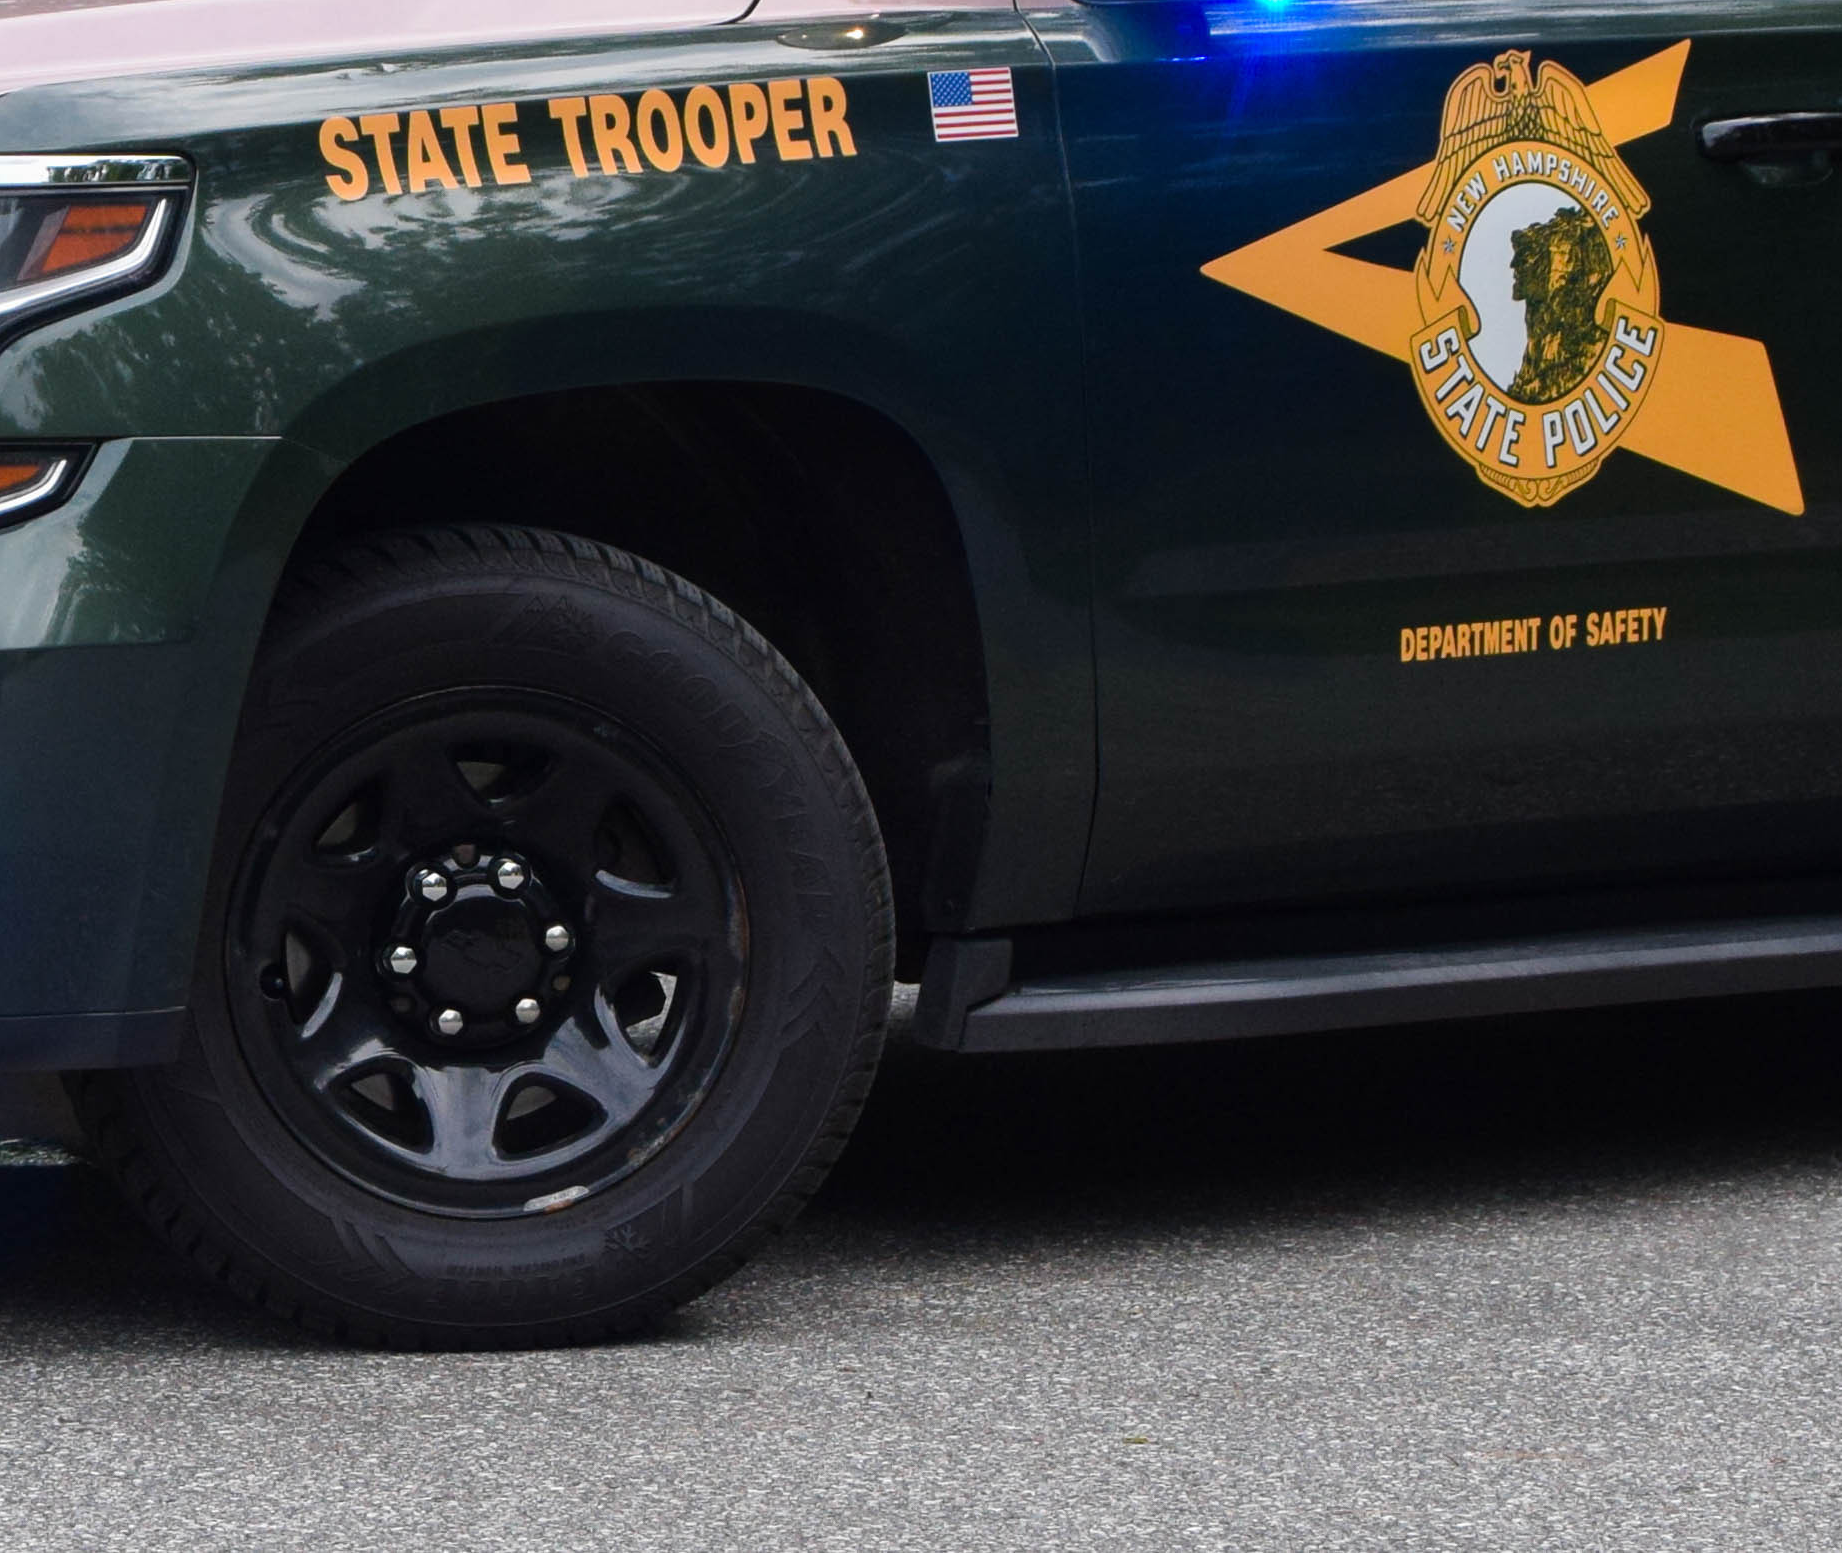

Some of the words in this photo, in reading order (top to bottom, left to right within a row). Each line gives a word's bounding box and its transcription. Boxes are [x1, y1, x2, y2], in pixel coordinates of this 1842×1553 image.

[319, 102, 532, 201] STATE
[549, 76, 857, 178] TROOPER
[1446, 172, 1488, 232] NEW
[1492, 151, 1620, 230] HAMPSHIRE
[1419, 326, 1526, 467] STATE
[1542, 315, 1658, 468] POLICE
[1400, 617, 1541, 662] DEPARTMENT
[1549, 614, 1578, 650] OF
[1586, 606, 1668, 646] SAFETY
